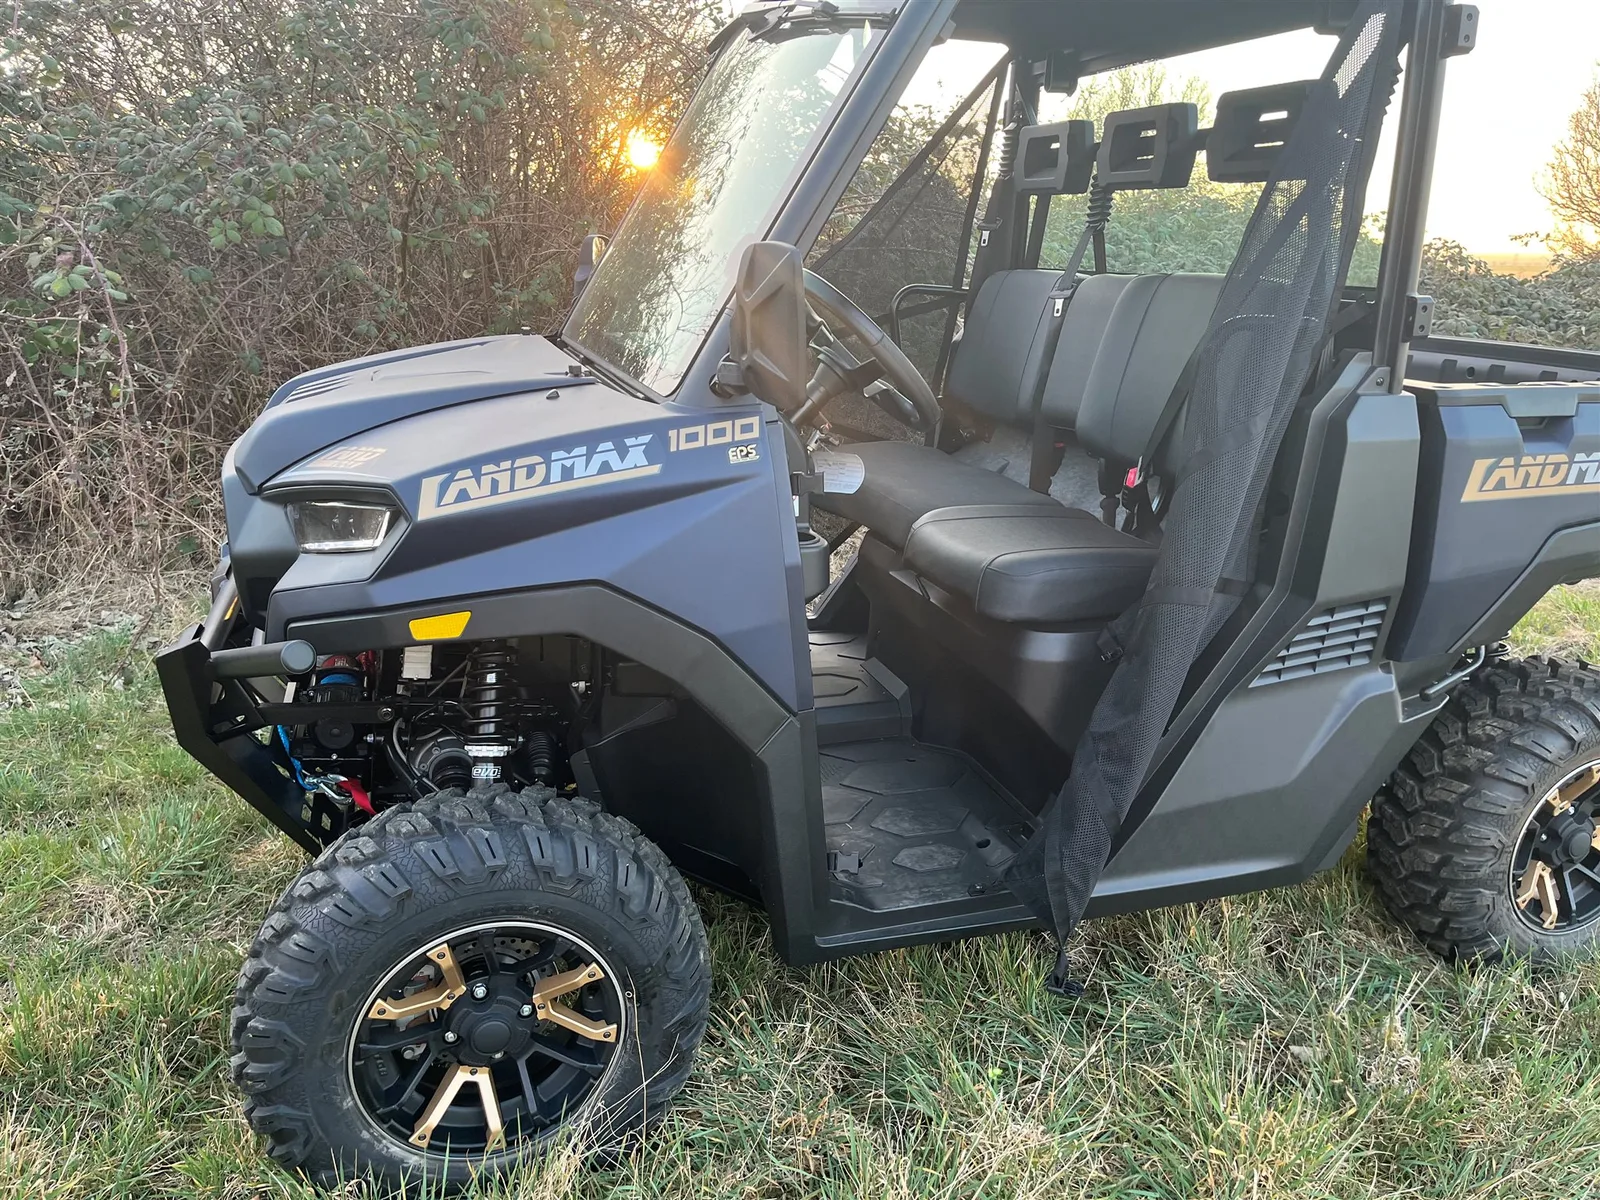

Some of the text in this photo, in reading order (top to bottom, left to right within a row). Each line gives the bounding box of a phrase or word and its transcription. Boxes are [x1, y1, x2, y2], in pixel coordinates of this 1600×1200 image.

[668, 415, 760, 452] 1000
[728, 443, 758, 461] EPS
[417, 433, 664, 522] LANDMAX
[1460, 451, 1600, 503] LANDM
